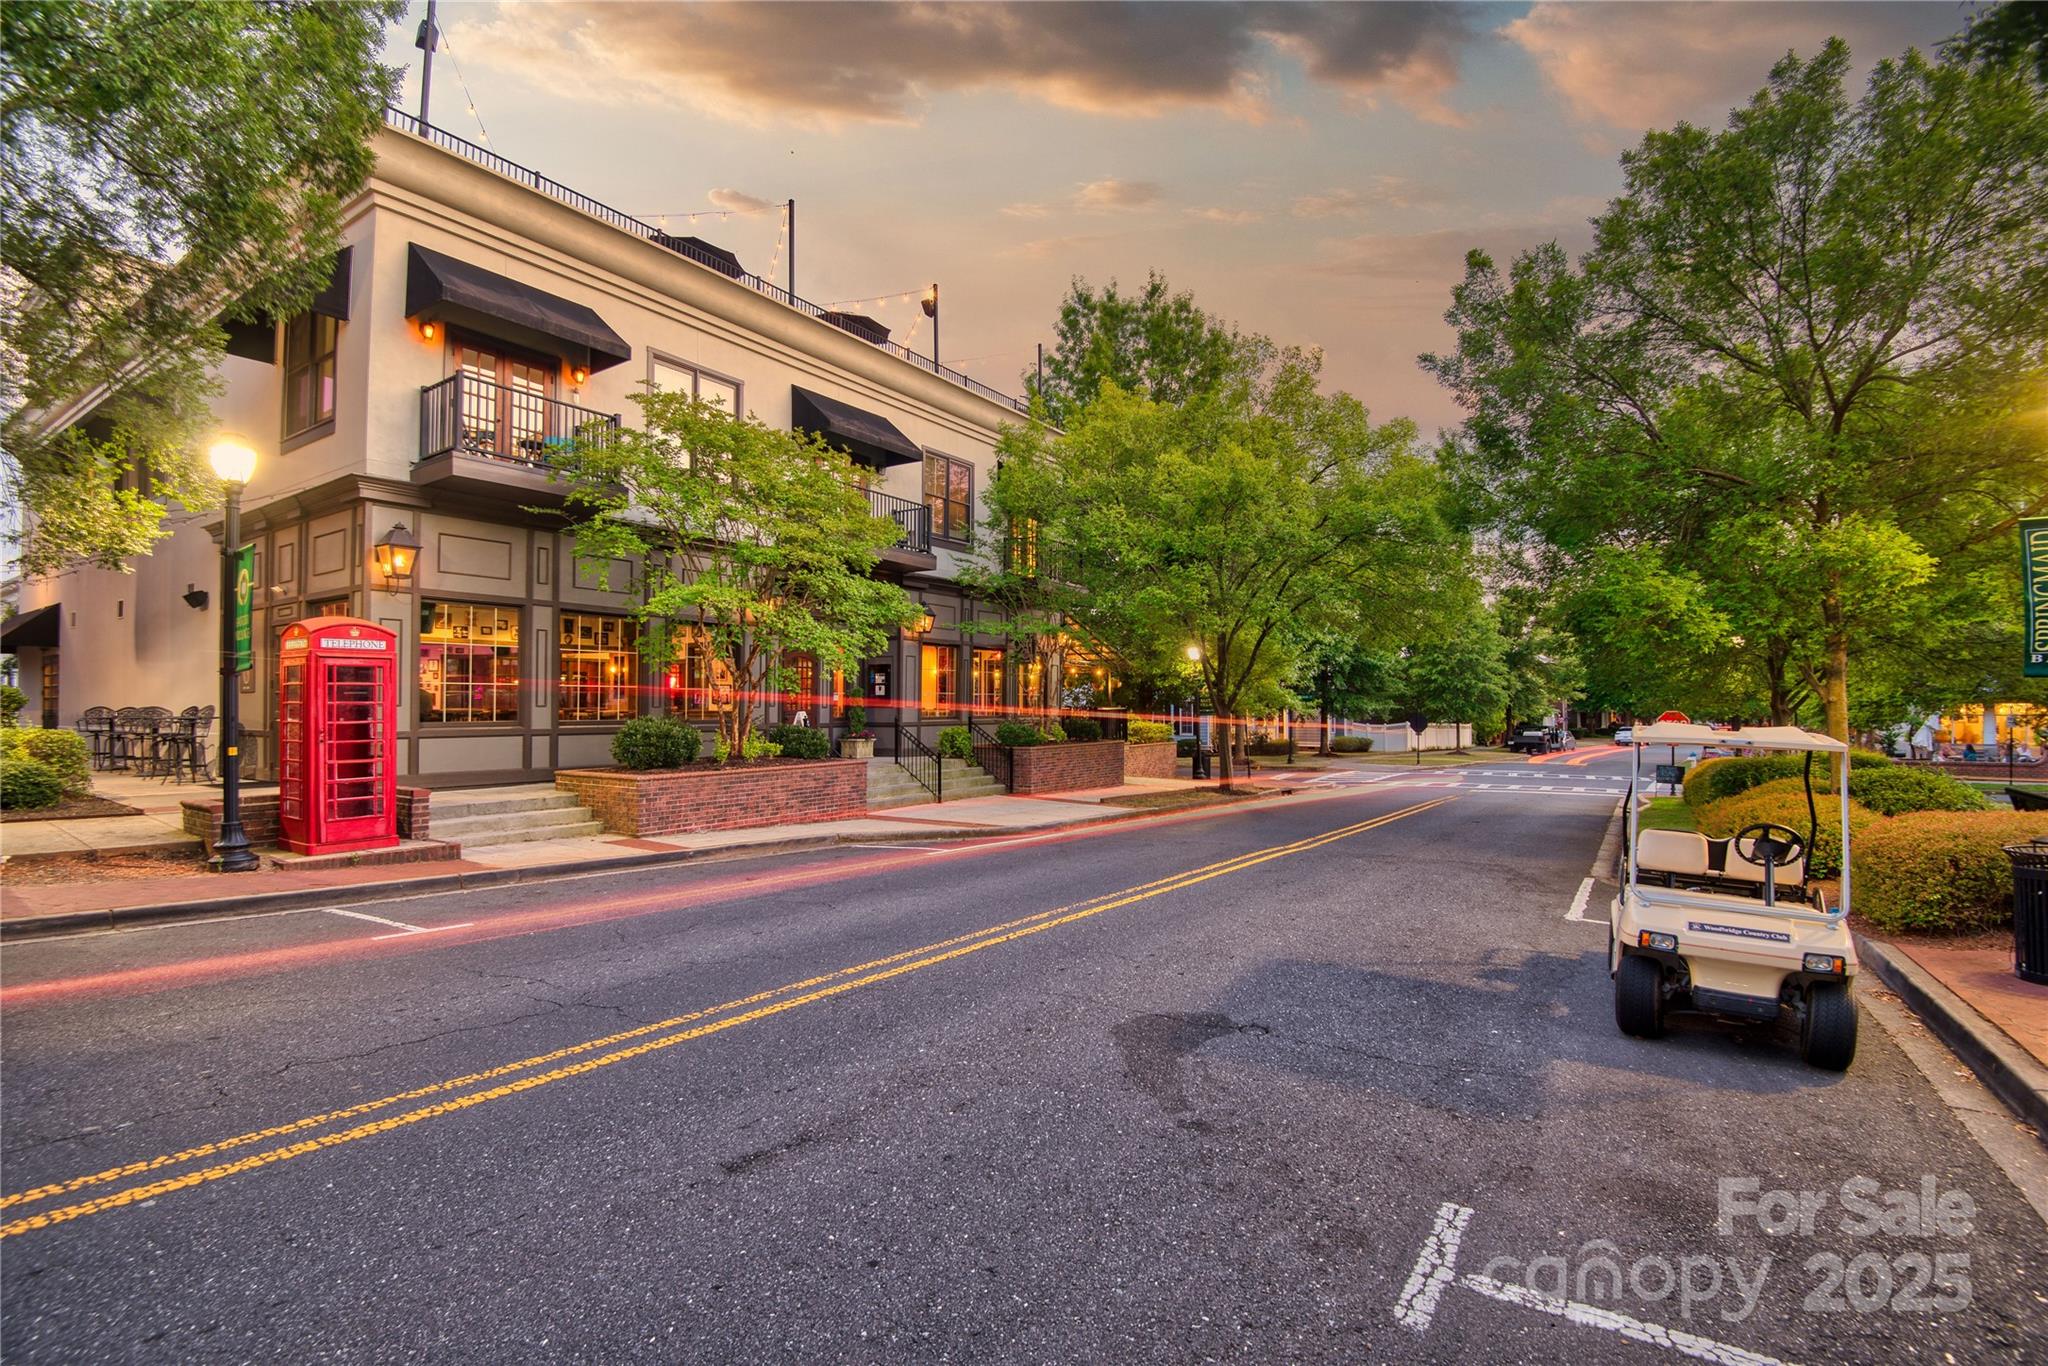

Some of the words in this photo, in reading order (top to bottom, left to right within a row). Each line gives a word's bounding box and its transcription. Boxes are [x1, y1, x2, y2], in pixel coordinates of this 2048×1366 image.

[324, 639, 385, 649] TELEPHONE
[1704, 925, 1742, 935] Woodbridge
[1743, 929, 1770, 939] Country
[1771, 932, 1788, 940] Club
